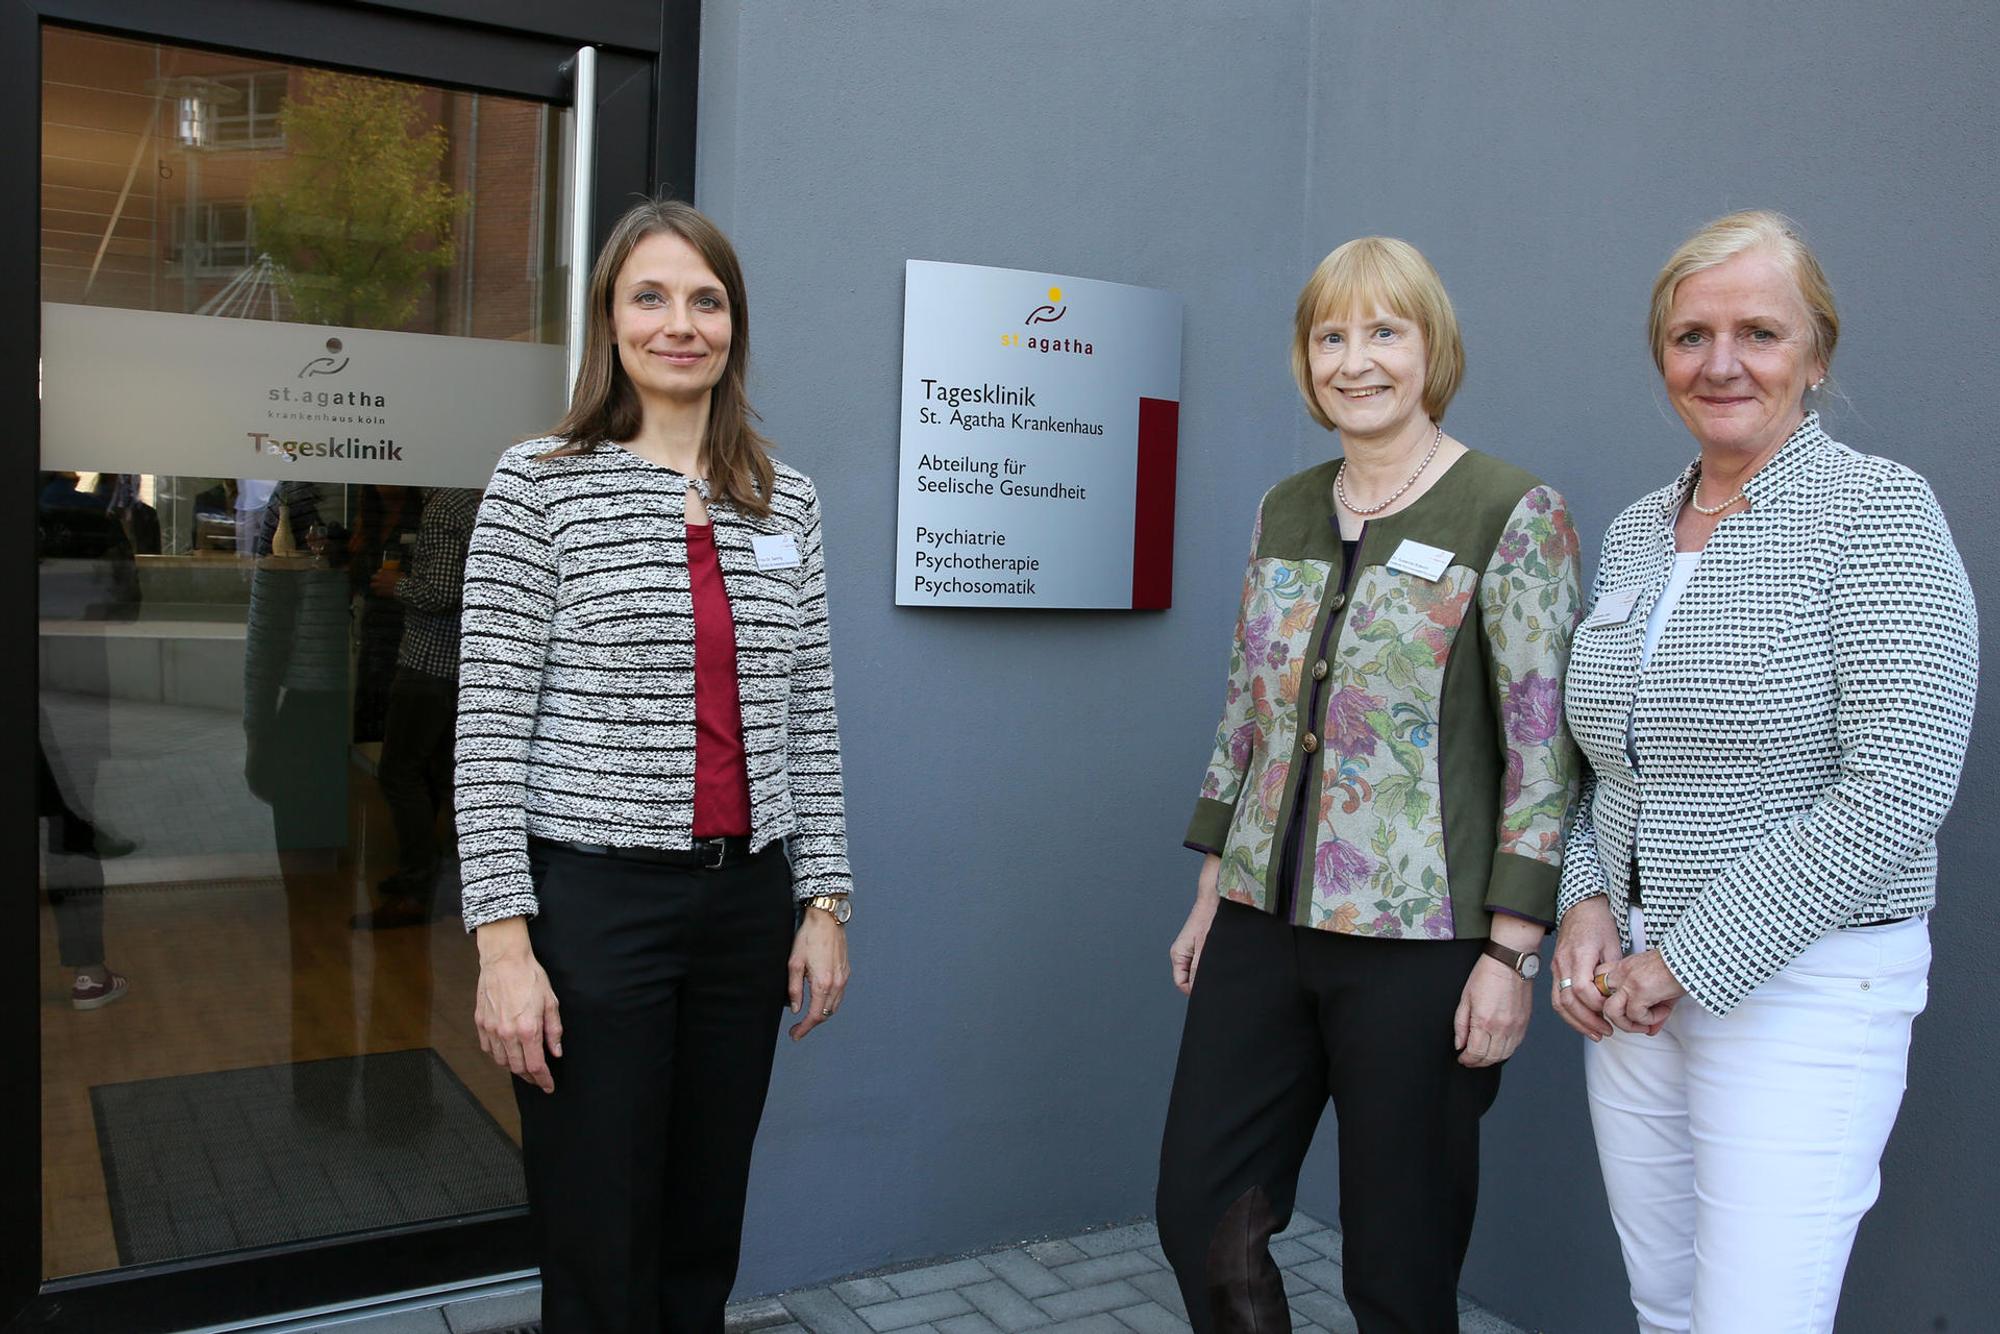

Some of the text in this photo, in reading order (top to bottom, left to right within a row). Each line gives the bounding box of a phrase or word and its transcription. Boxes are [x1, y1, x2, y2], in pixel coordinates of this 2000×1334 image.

[1028, 337, 1093, 355] agatha
[921, 379, 1036, 408] Tagesklinik
[267, 410, 353, 422] krankenhaus
[919, 408, 1104, 436] St. Agatha Krankenhaus
[247, 432, 404, 462] Tagesklinik
[918, 454, 1026, 478] Abteilung für
[917, 477, 1086, 500] Seelische Gesundheit
[916, 527, 1006, 548] Psychiatrie
[915, 552, 1040, 575] Psychotherapie
[914, 576, 1036, 597] Psychosomatik
